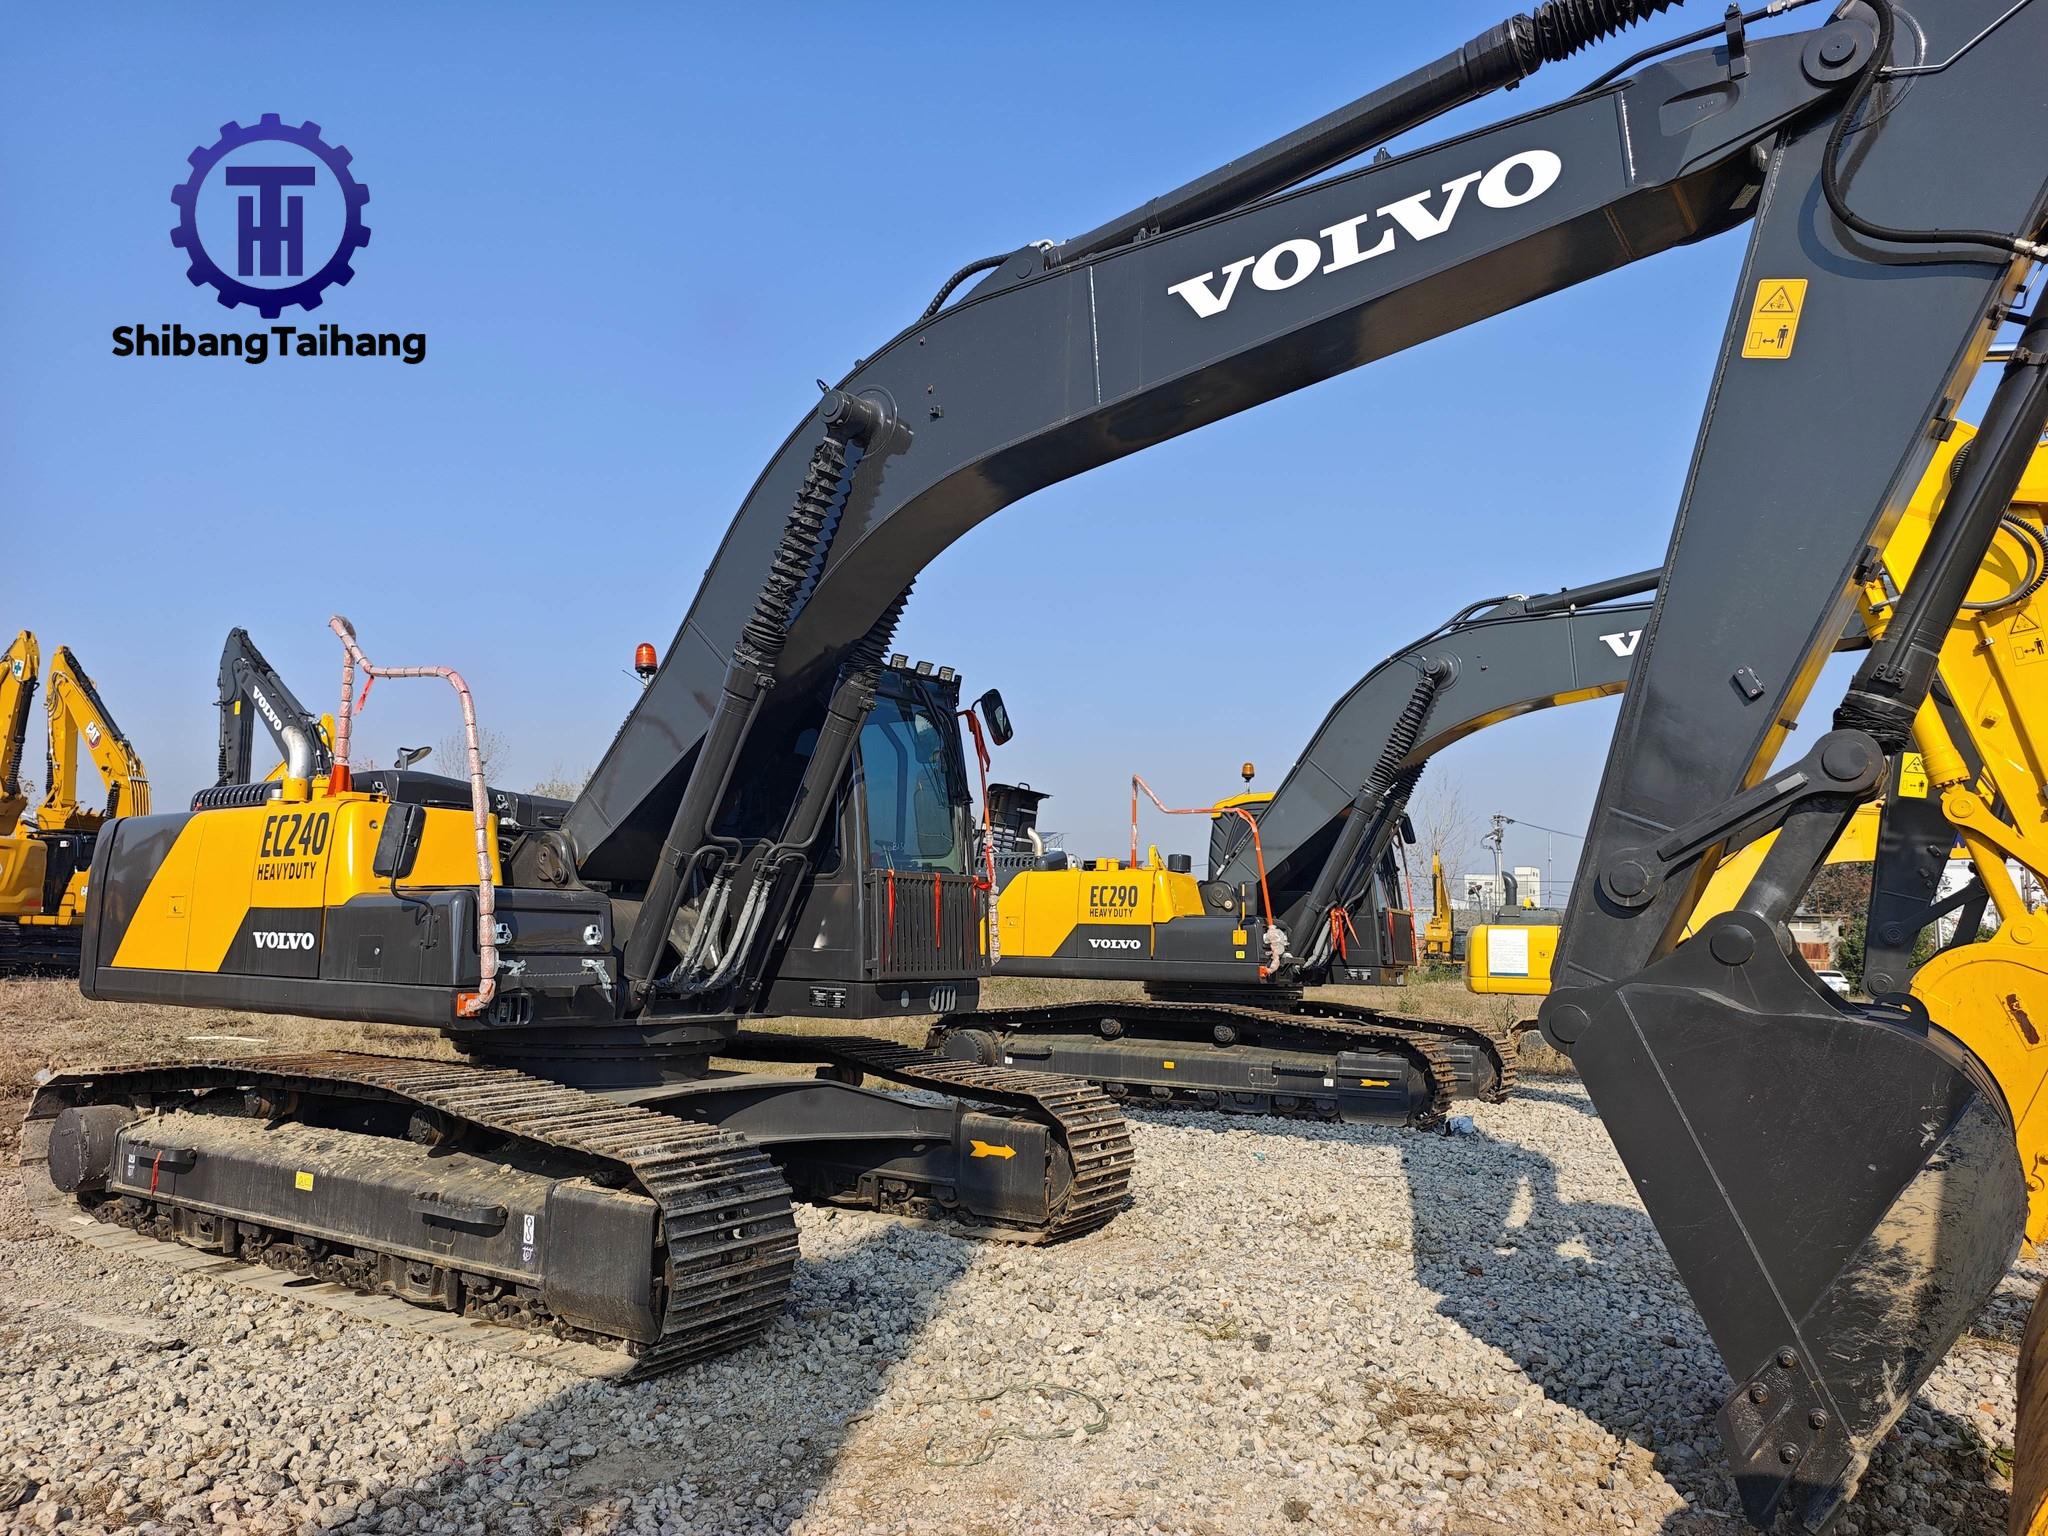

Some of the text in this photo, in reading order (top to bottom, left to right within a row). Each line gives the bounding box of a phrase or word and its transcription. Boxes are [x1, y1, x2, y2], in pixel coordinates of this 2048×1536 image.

[1168, 150, 1561, 317] VOLVO
[252, 685, 282, 731] VOLVO
[86, 721, 101, 743] CAT
[260, 812, 328, 858] EC240
[256, 861, 317, 881] HEAVYDUTY
[1090, 886, 1138, 907] EC290
[253, 932, 315, 949] VOLVO
[1089, 939, 1141, 949] VOLVO
